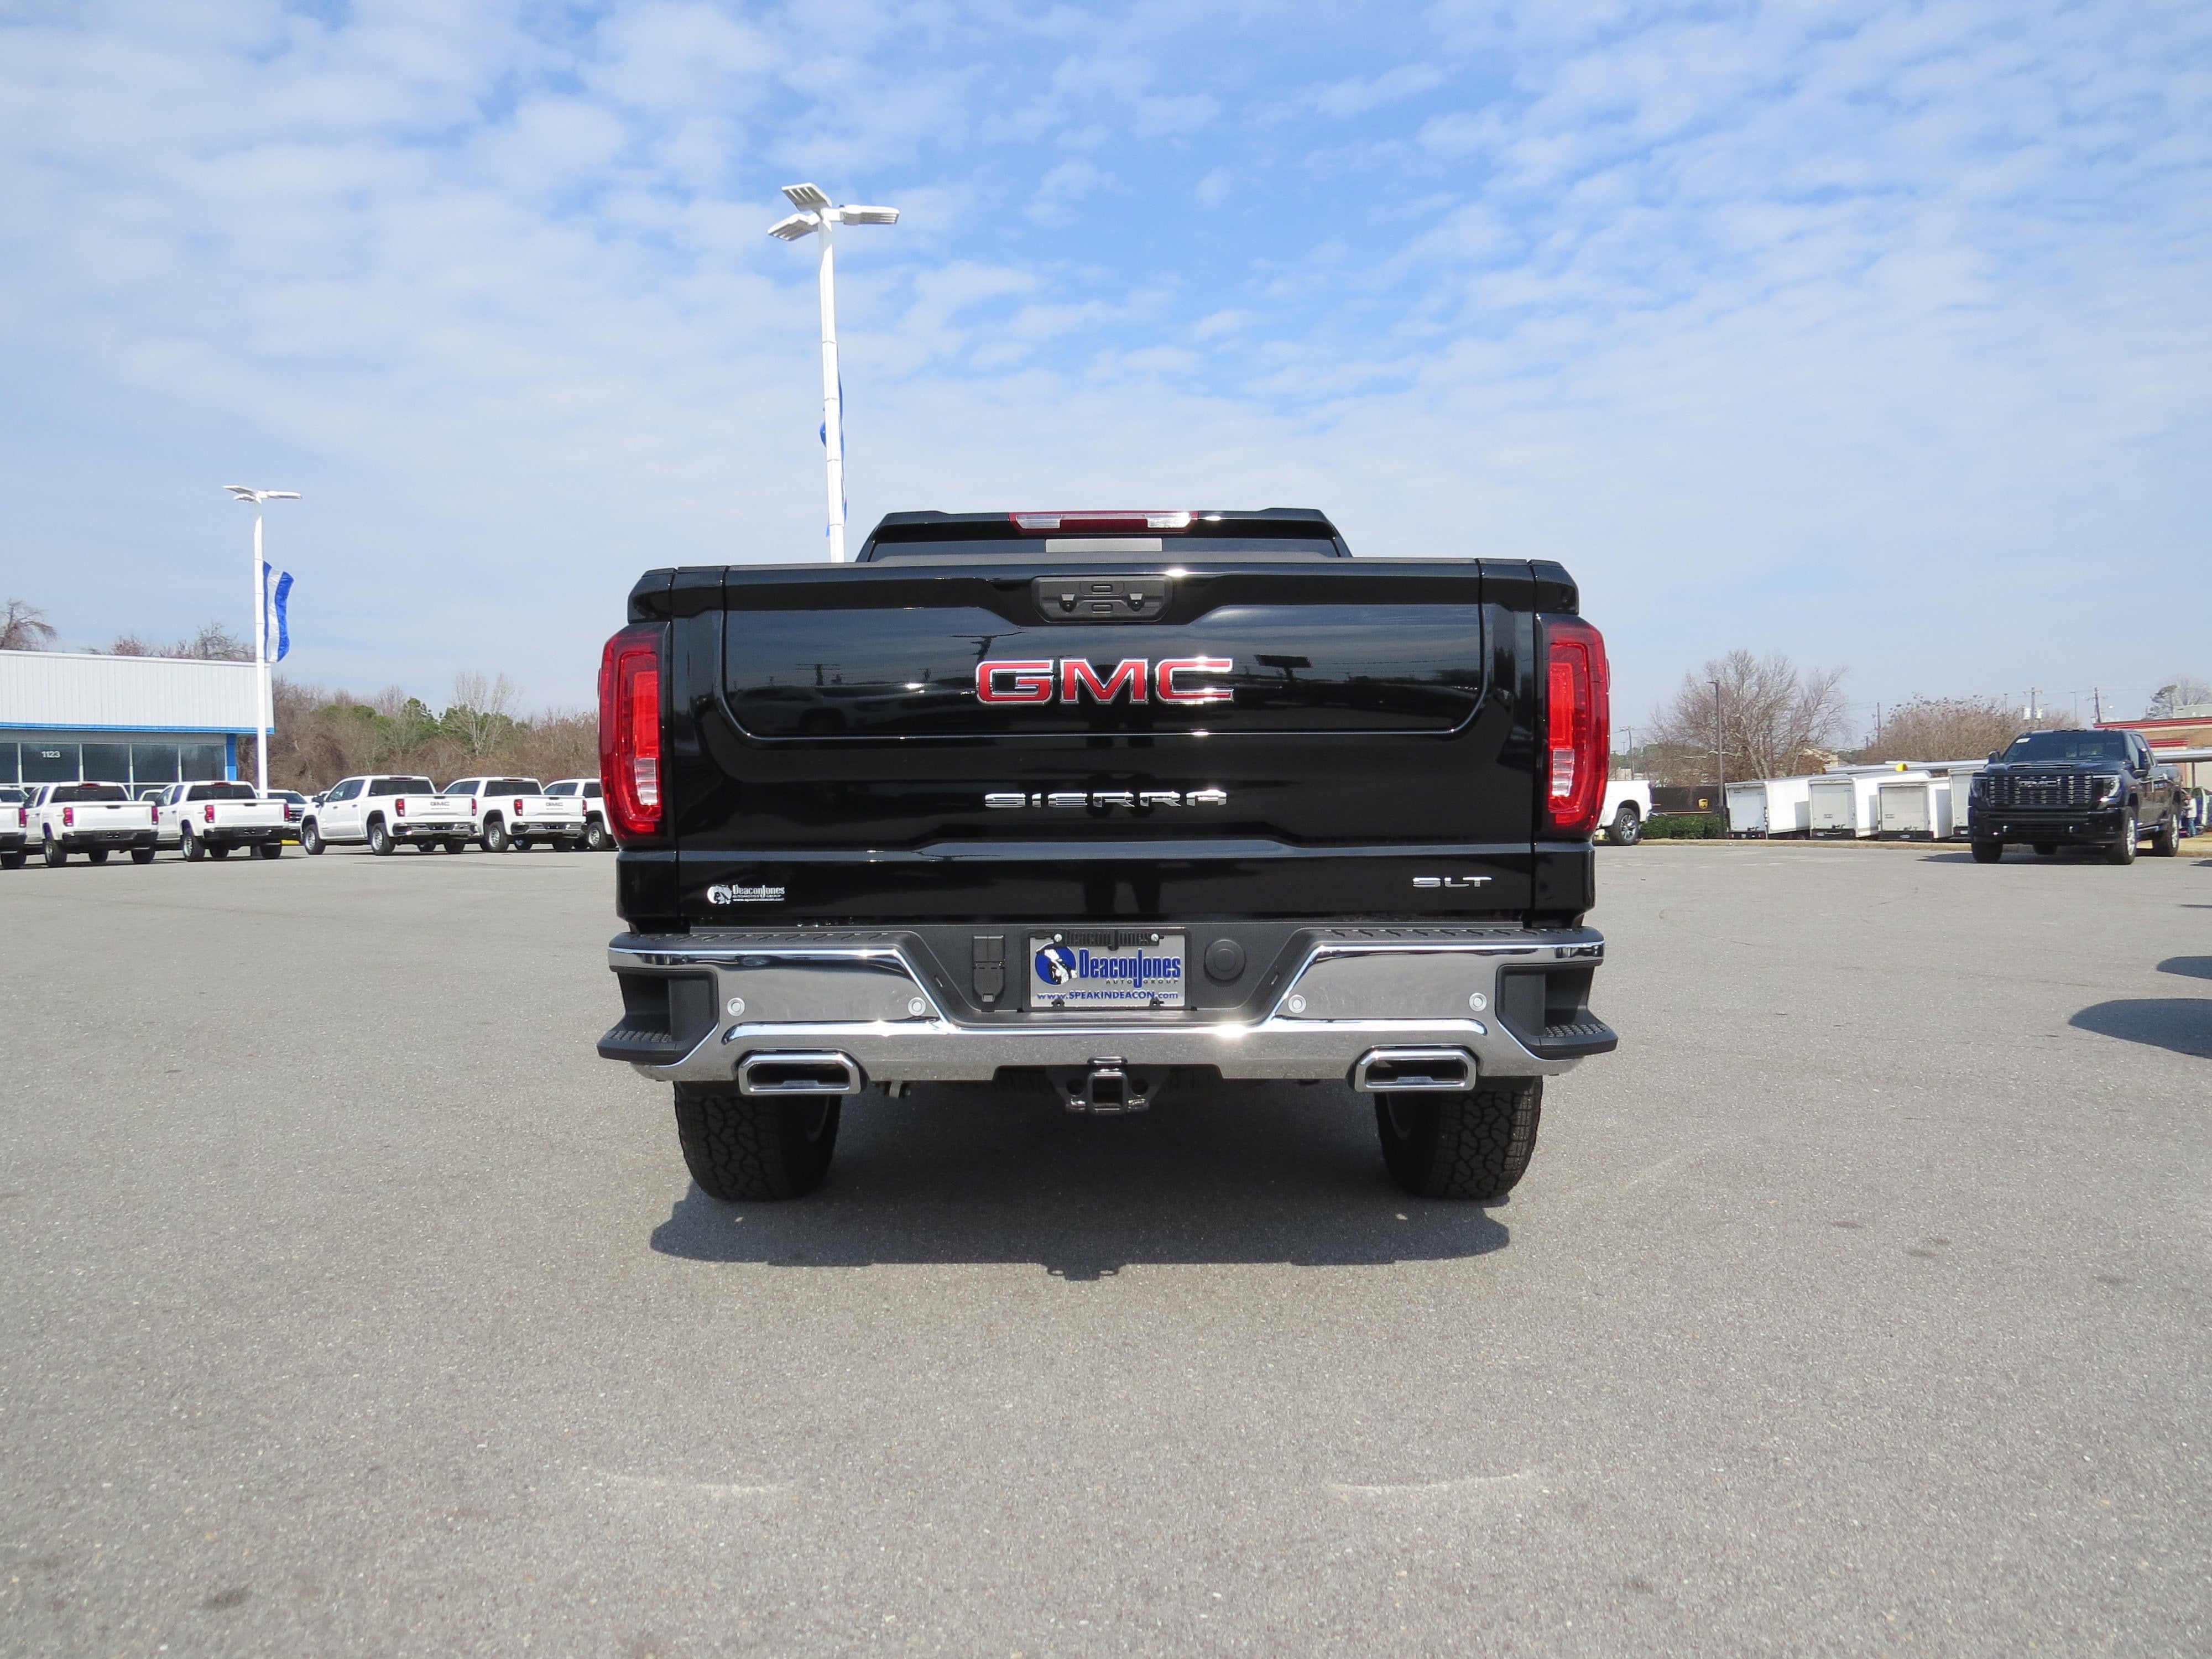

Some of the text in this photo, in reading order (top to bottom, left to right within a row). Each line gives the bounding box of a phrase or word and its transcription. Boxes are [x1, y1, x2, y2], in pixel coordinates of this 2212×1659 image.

[975, 658, 1234, 705] GMC
[985, 791, 1227, 808] SIERRA
[1412, 877, 1492, 888] SLT
[1079, 948, 1181, 988] DeaconJones
[1037, 989, 1178, 1000] www.SPEAKINDEACON.com
